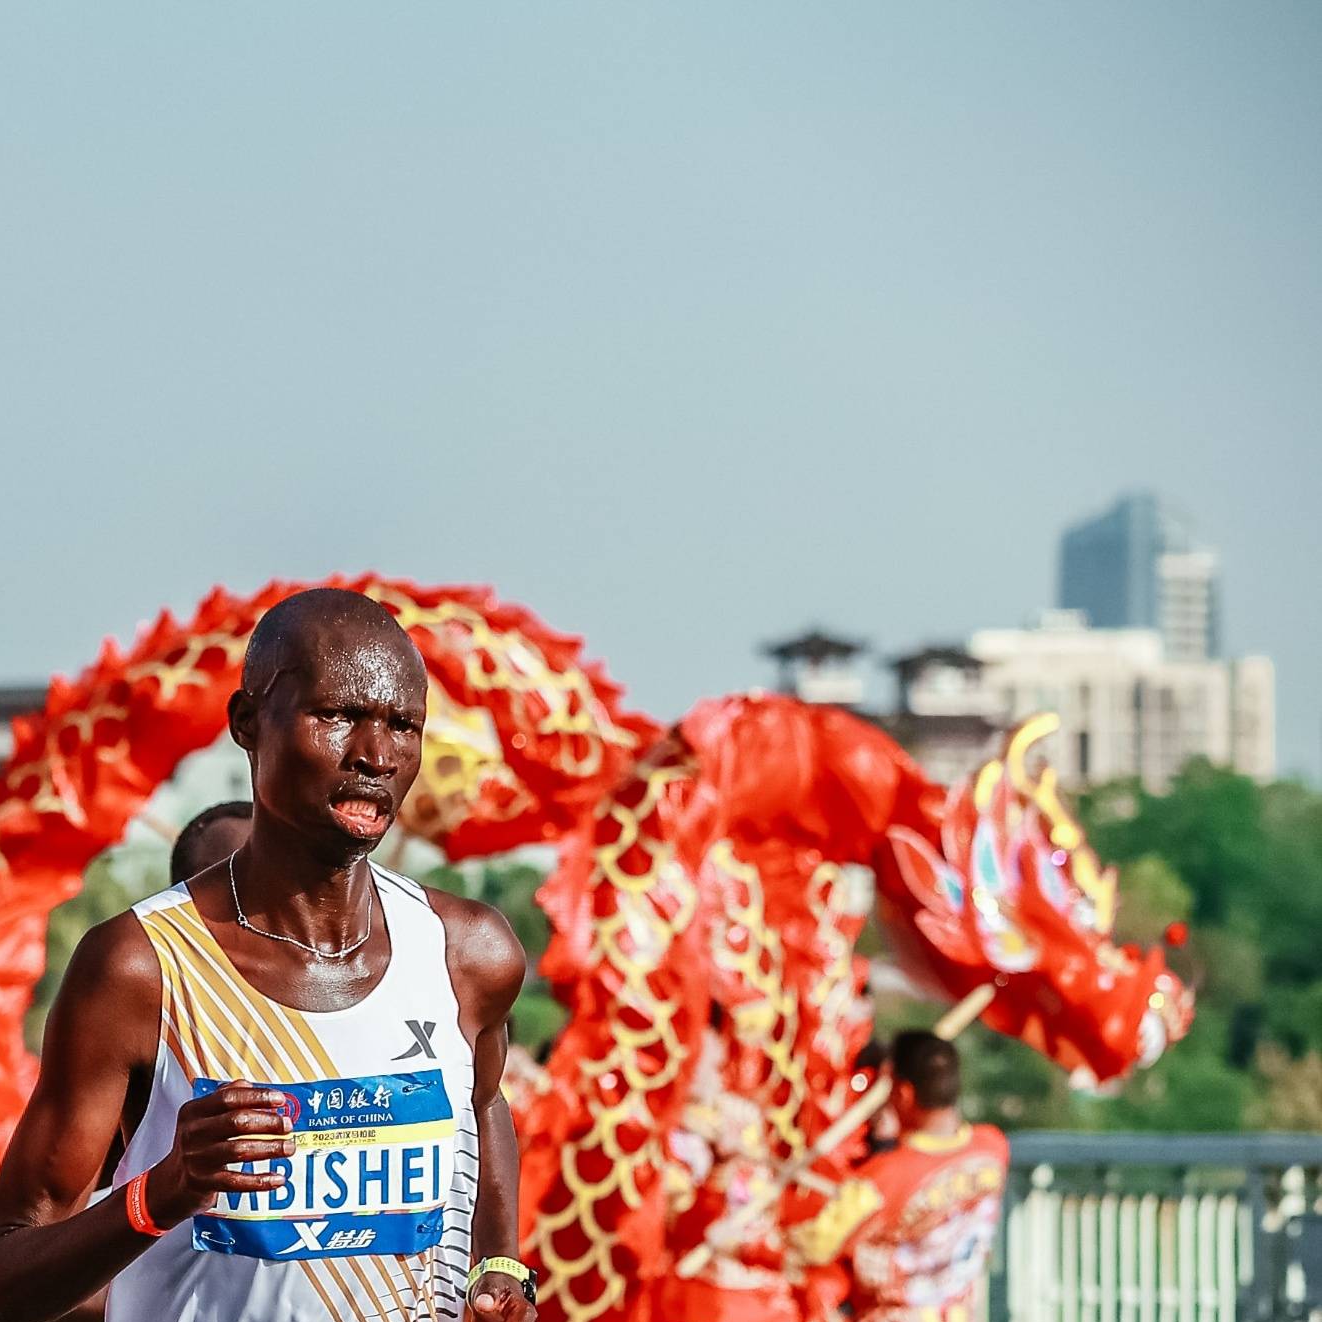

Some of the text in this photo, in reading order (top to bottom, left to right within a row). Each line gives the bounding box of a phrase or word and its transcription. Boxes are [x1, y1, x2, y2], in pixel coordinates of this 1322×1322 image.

[308, 1113, 394, 1127] BANK OF CHINA
[324, 1228, 377, 1250] 特步
